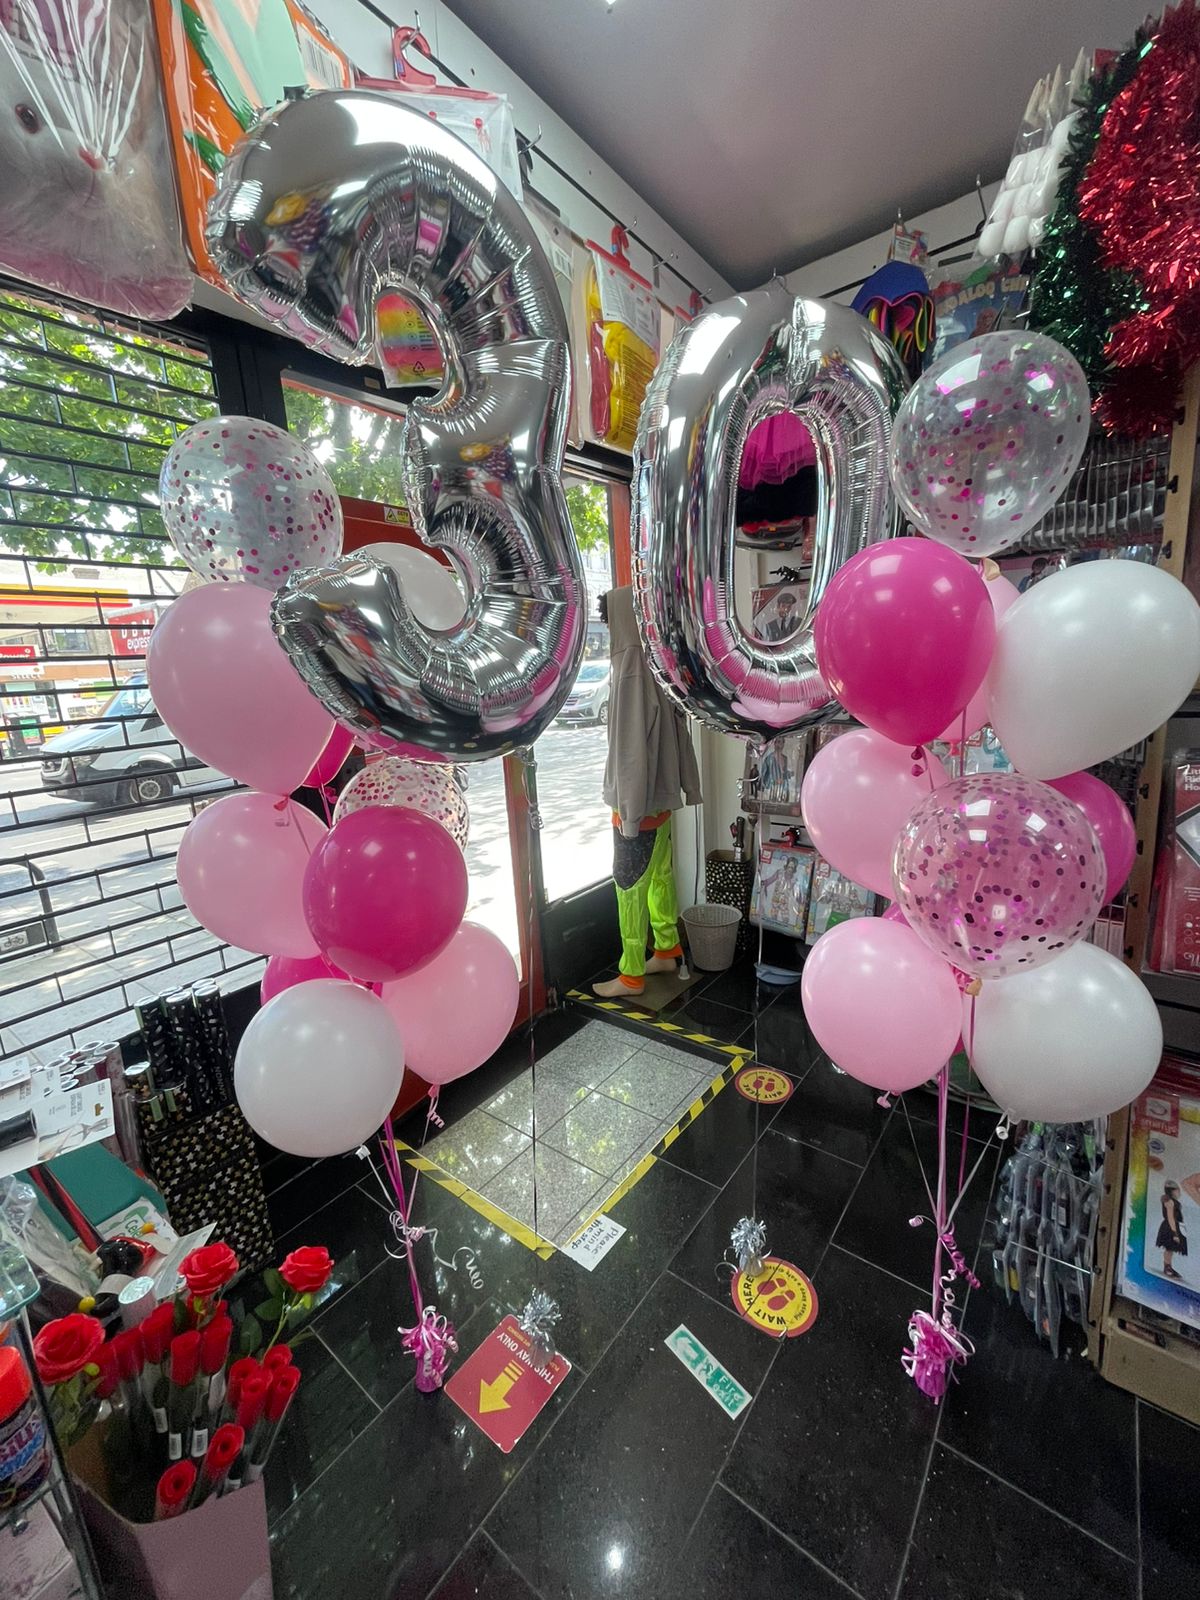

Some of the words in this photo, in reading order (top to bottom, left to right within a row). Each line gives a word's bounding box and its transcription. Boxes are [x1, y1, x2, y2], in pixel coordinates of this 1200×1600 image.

[206, 89, 586, 763] 3
[631, 290, 908, 741] 0
[587, 1219, 603, 1234] the
[571, 1232, 588, 1250] step
[583, 1228, 605, 1251] mind
[591, 1227, 619, 1255] Please
[743, 1275, 755, 1306] HERE
[754, 1309, 787, 1325] WAIT
[497, 1332, 519, 1351] ONLY
[534, 1366, 555, 1385] THIS
[713, 1384, 735, 1407] exit
[719, 1376, 742, 1401] Fire
